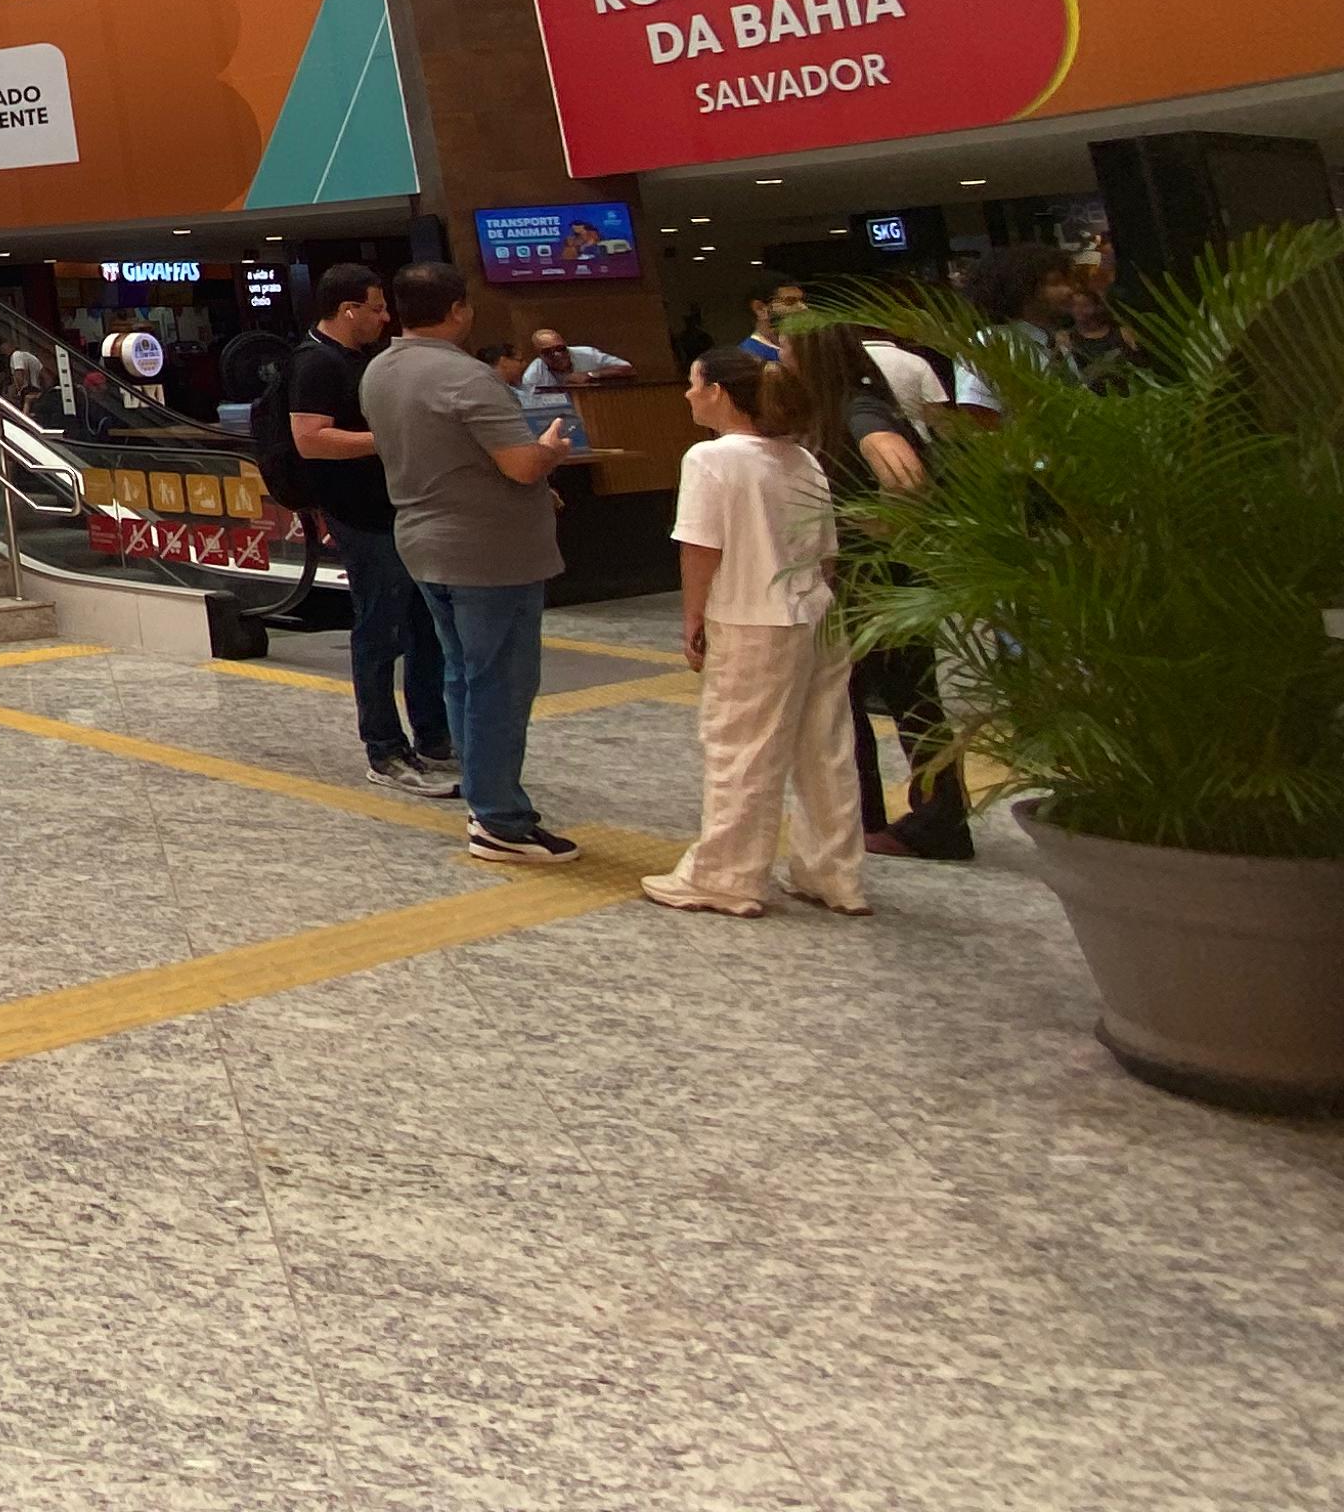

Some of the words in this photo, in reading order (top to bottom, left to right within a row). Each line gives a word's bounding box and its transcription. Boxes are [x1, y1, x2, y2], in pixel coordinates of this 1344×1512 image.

[645, 13, 723, 65] DA
[696, 53, 892, 114] SALVADOR
[486, 216, 561, 229] TRANSPORTE
[488, 229, 503, 239] DE
[507, 227, 561, 238] ANIMAIS
